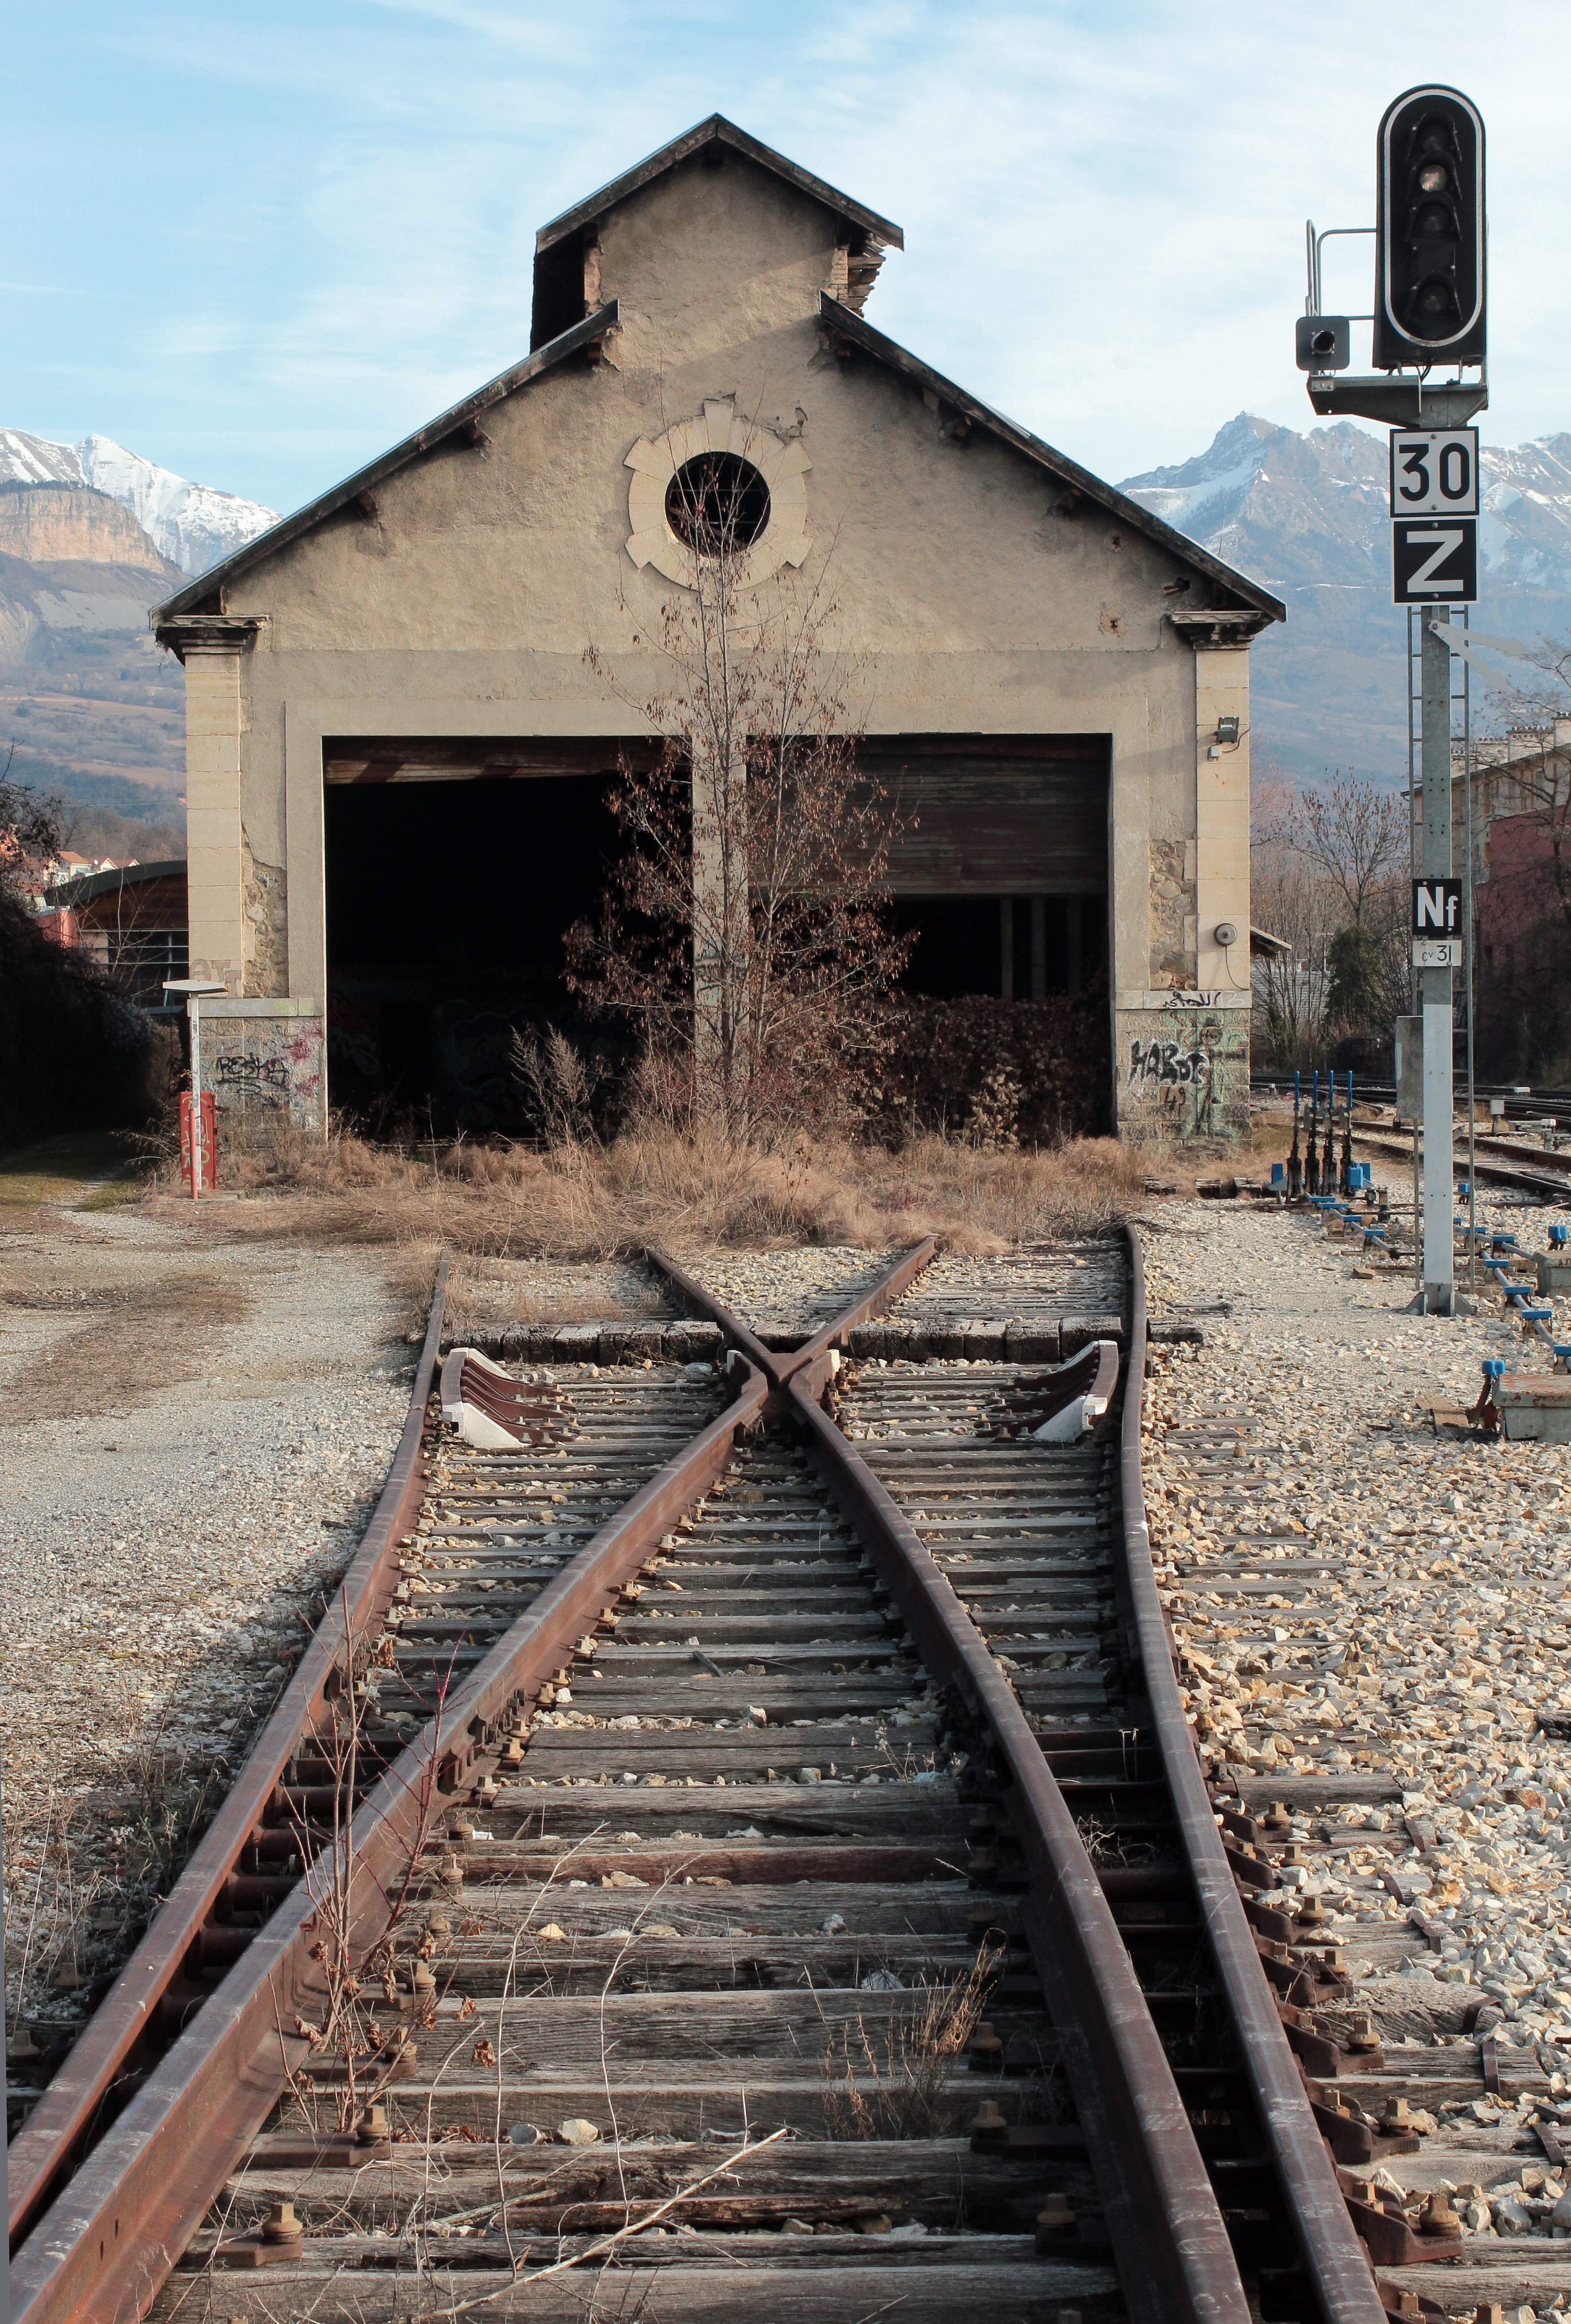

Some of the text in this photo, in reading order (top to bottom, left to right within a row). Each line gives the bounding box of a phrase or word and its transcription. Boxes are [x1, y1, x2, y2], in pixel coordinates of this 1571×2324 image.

[1399, 442, 1470, 502] 30
[1406, 530, 1464, 593] Z
[1417, 886, 1458, 927] Nf
[1436, 945, 1451, 962] 31
